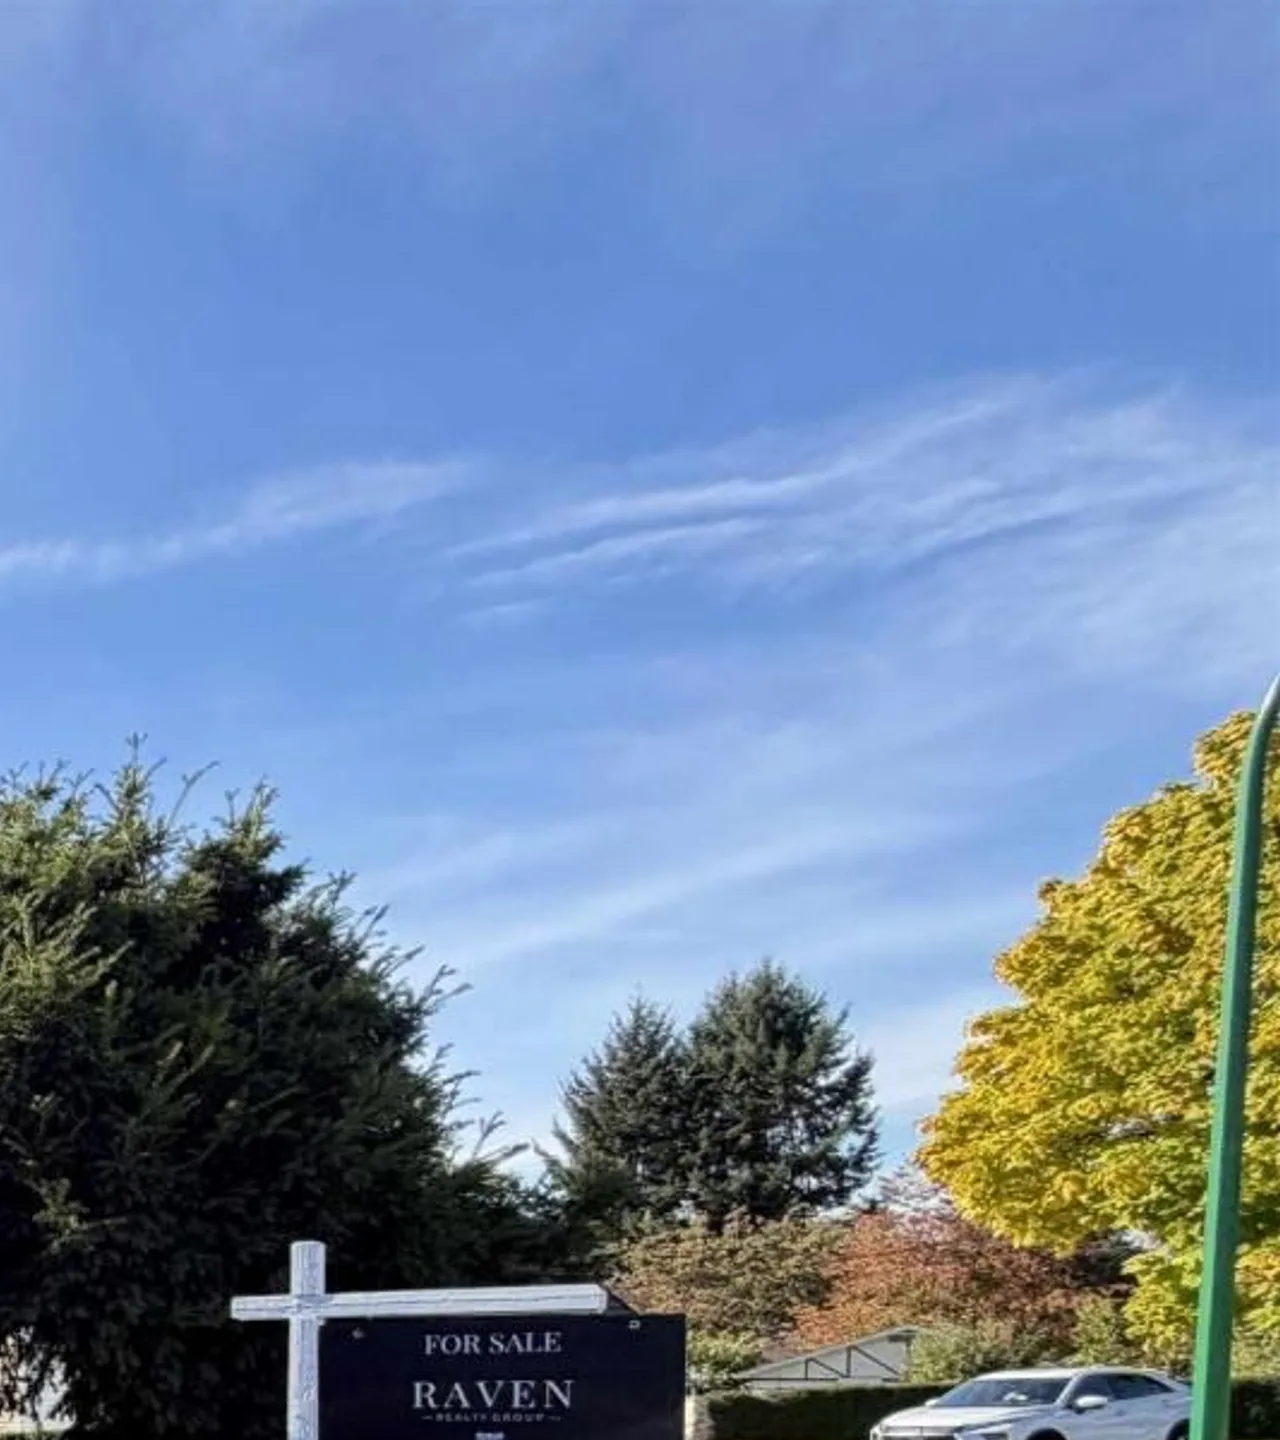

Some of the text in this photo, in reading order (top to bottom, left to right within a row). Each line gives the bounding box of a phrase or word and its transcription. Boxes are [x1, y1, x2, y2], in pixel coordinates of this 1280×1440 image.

[424, 1331, 564, 1355] FOR SALE
[412, 1380, 576, 1410] RAVEN
